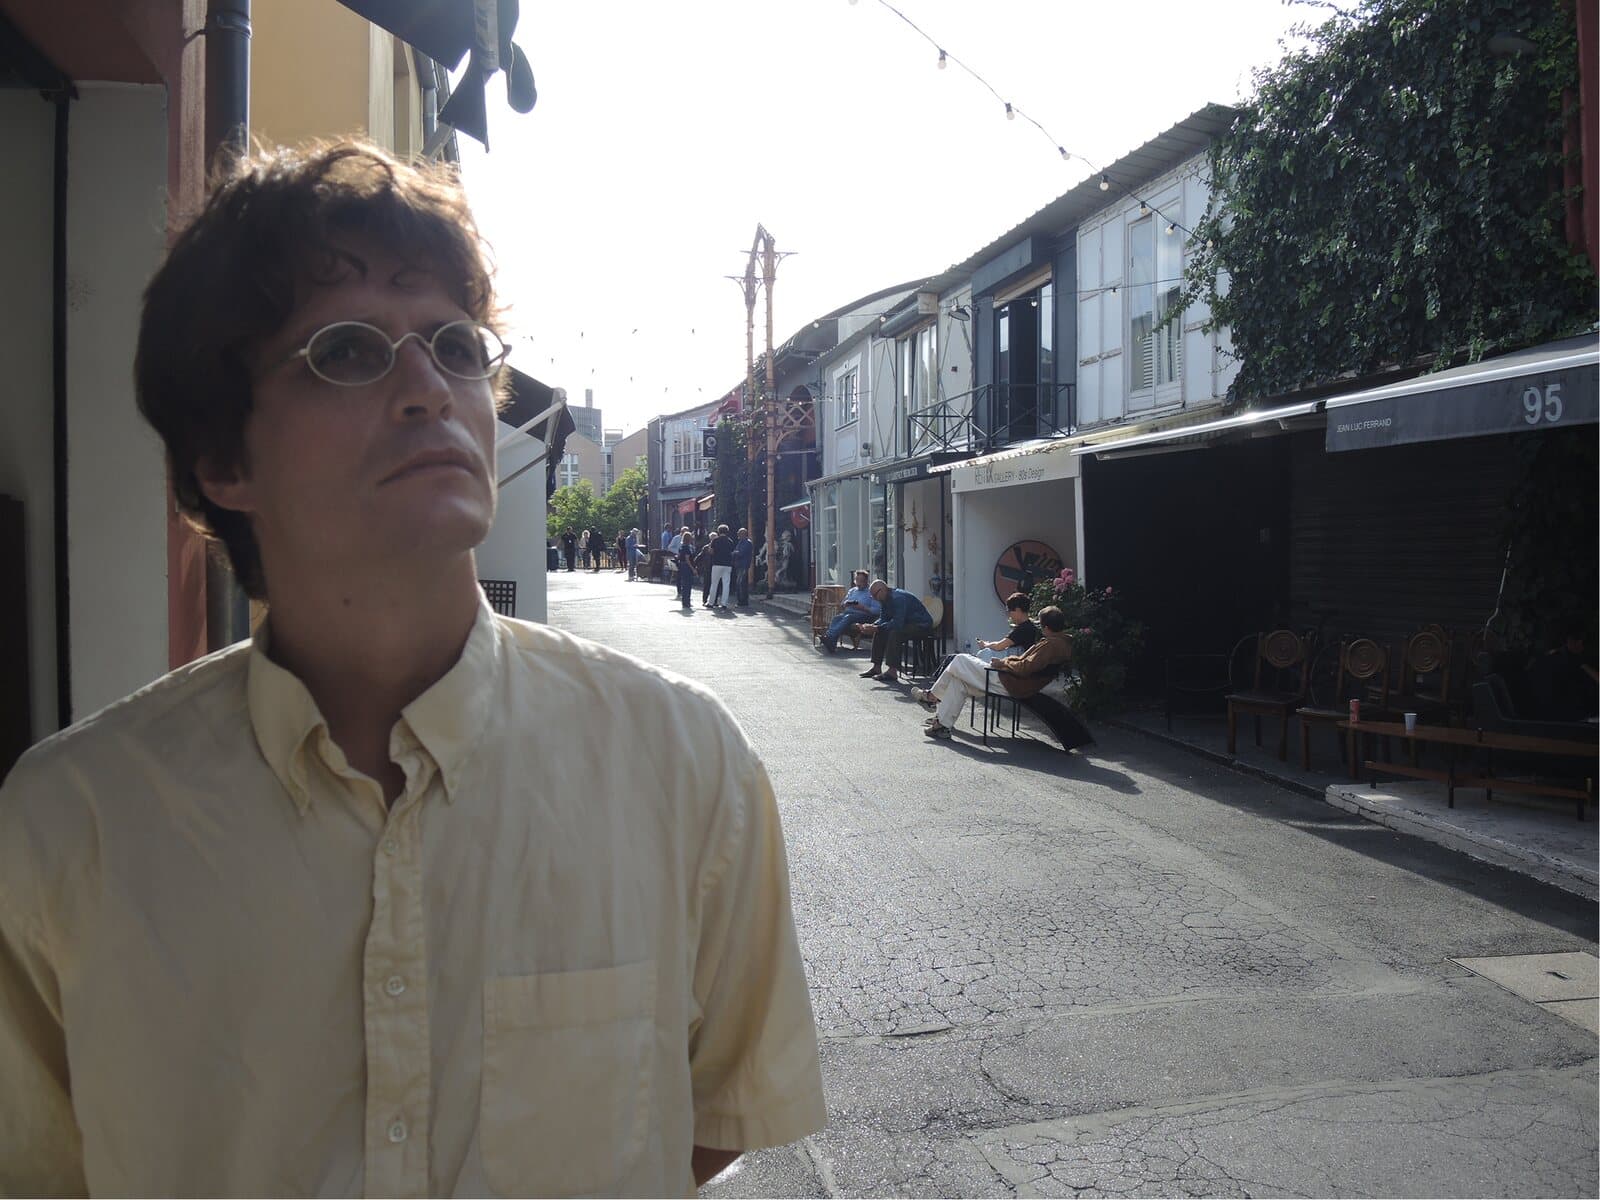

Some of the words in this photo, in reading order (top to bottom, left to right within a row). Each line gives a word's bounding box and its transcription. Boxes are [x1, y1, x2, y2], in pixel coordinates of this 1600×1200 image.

[1523, 383, 1563, 425] 95
[1336, 424, 1350, 433] JEAN
[1350, 422, 1362, 431] LUC
[1363, 417, 1392, 429] FERRAND
[1028, 466, 1045, 481] Design
